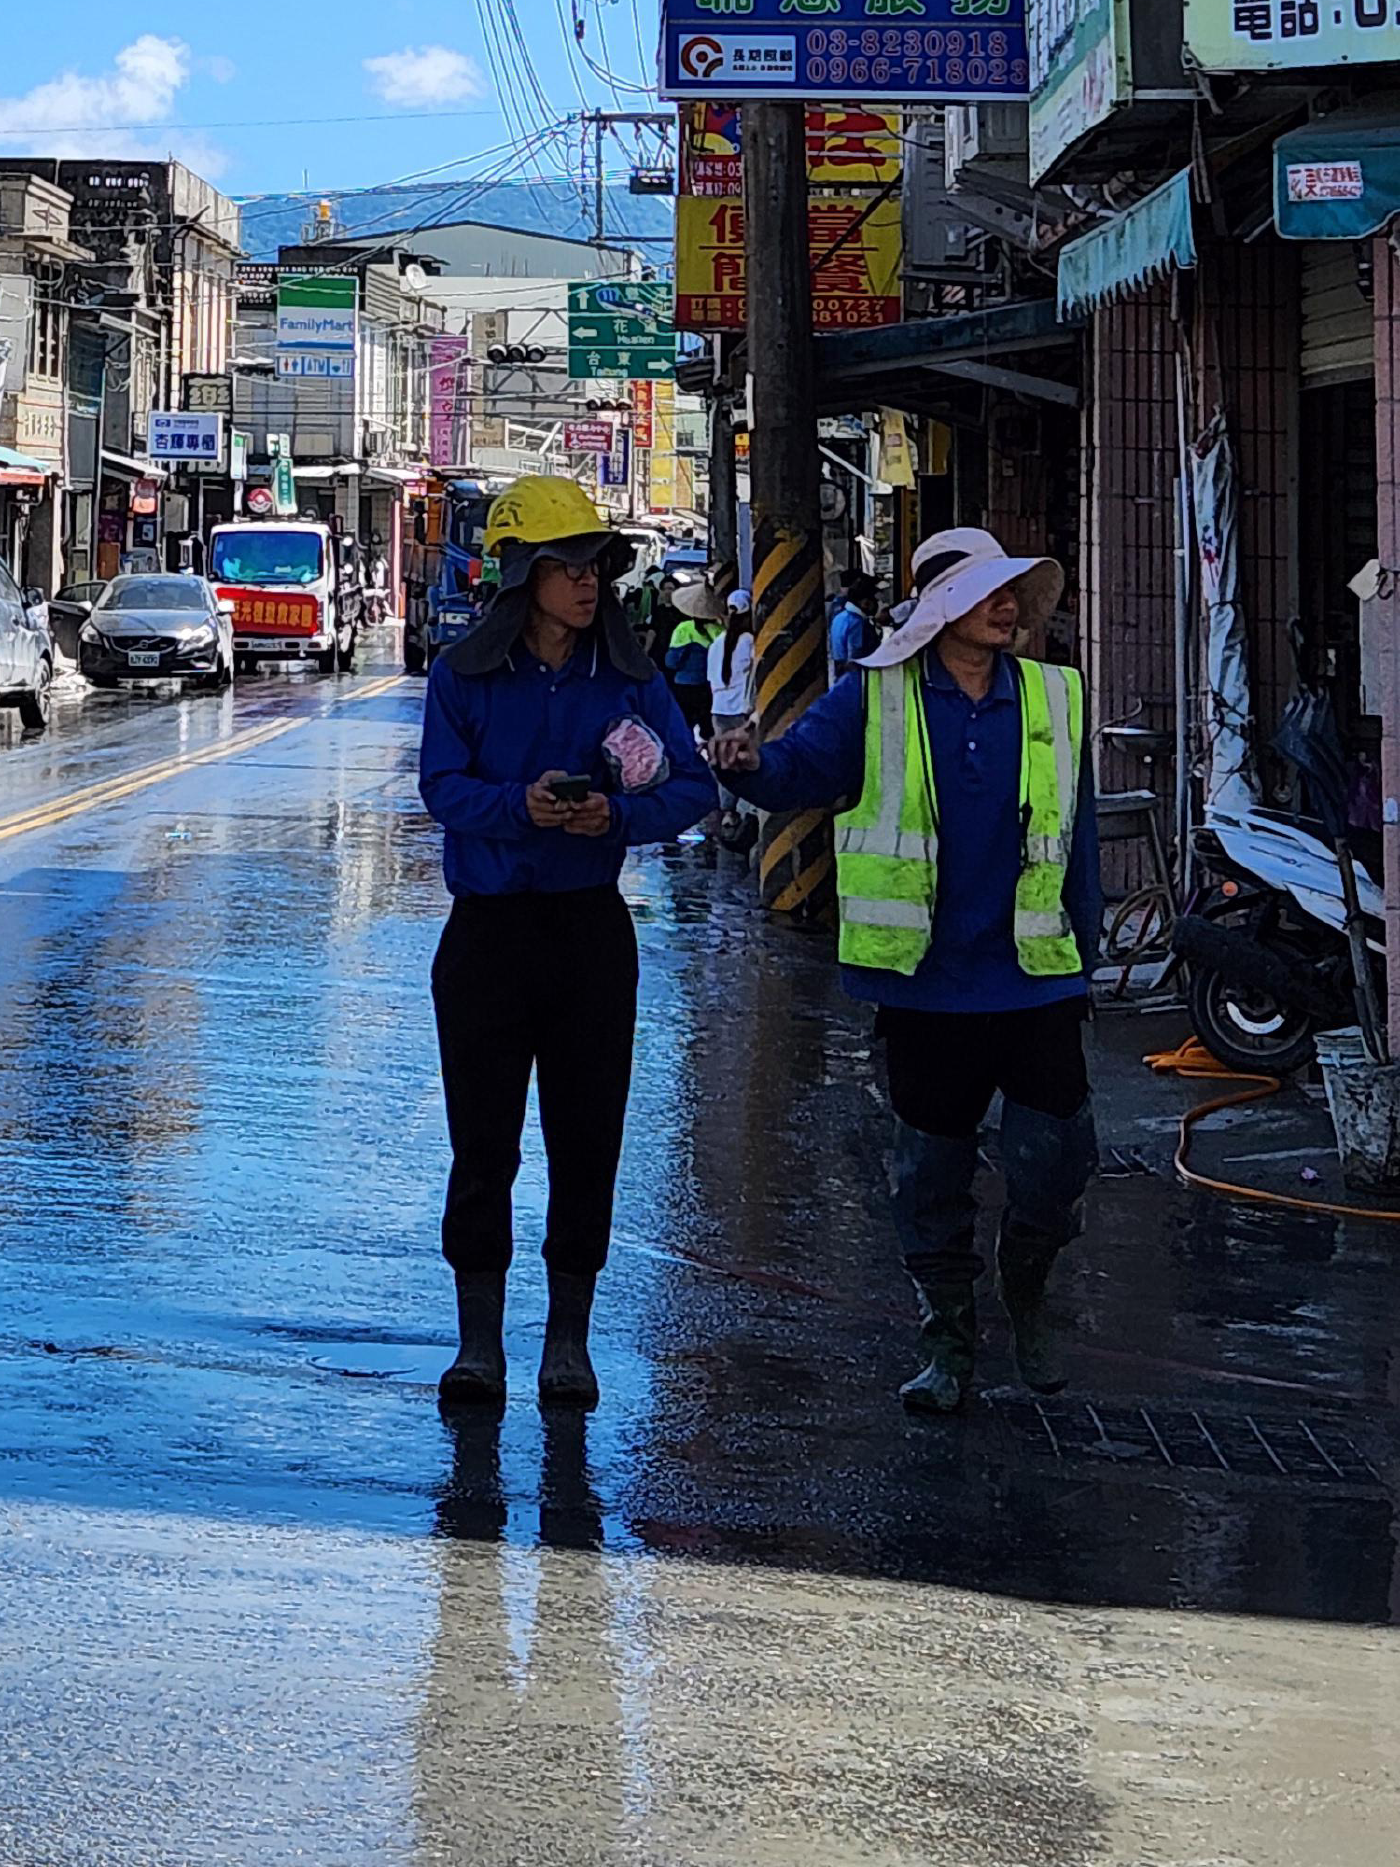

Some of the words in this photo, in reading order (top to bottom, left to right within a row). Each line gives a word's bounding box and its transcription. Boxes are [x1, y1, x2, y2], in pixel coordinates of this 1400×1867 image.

[806, 29, 1008, 56] 03-8230918
[806, 57, 1029, 84] 0966-718023
[280, 317, 354, 333] FamilyMart
[307, 359, 326, 371] ATM
